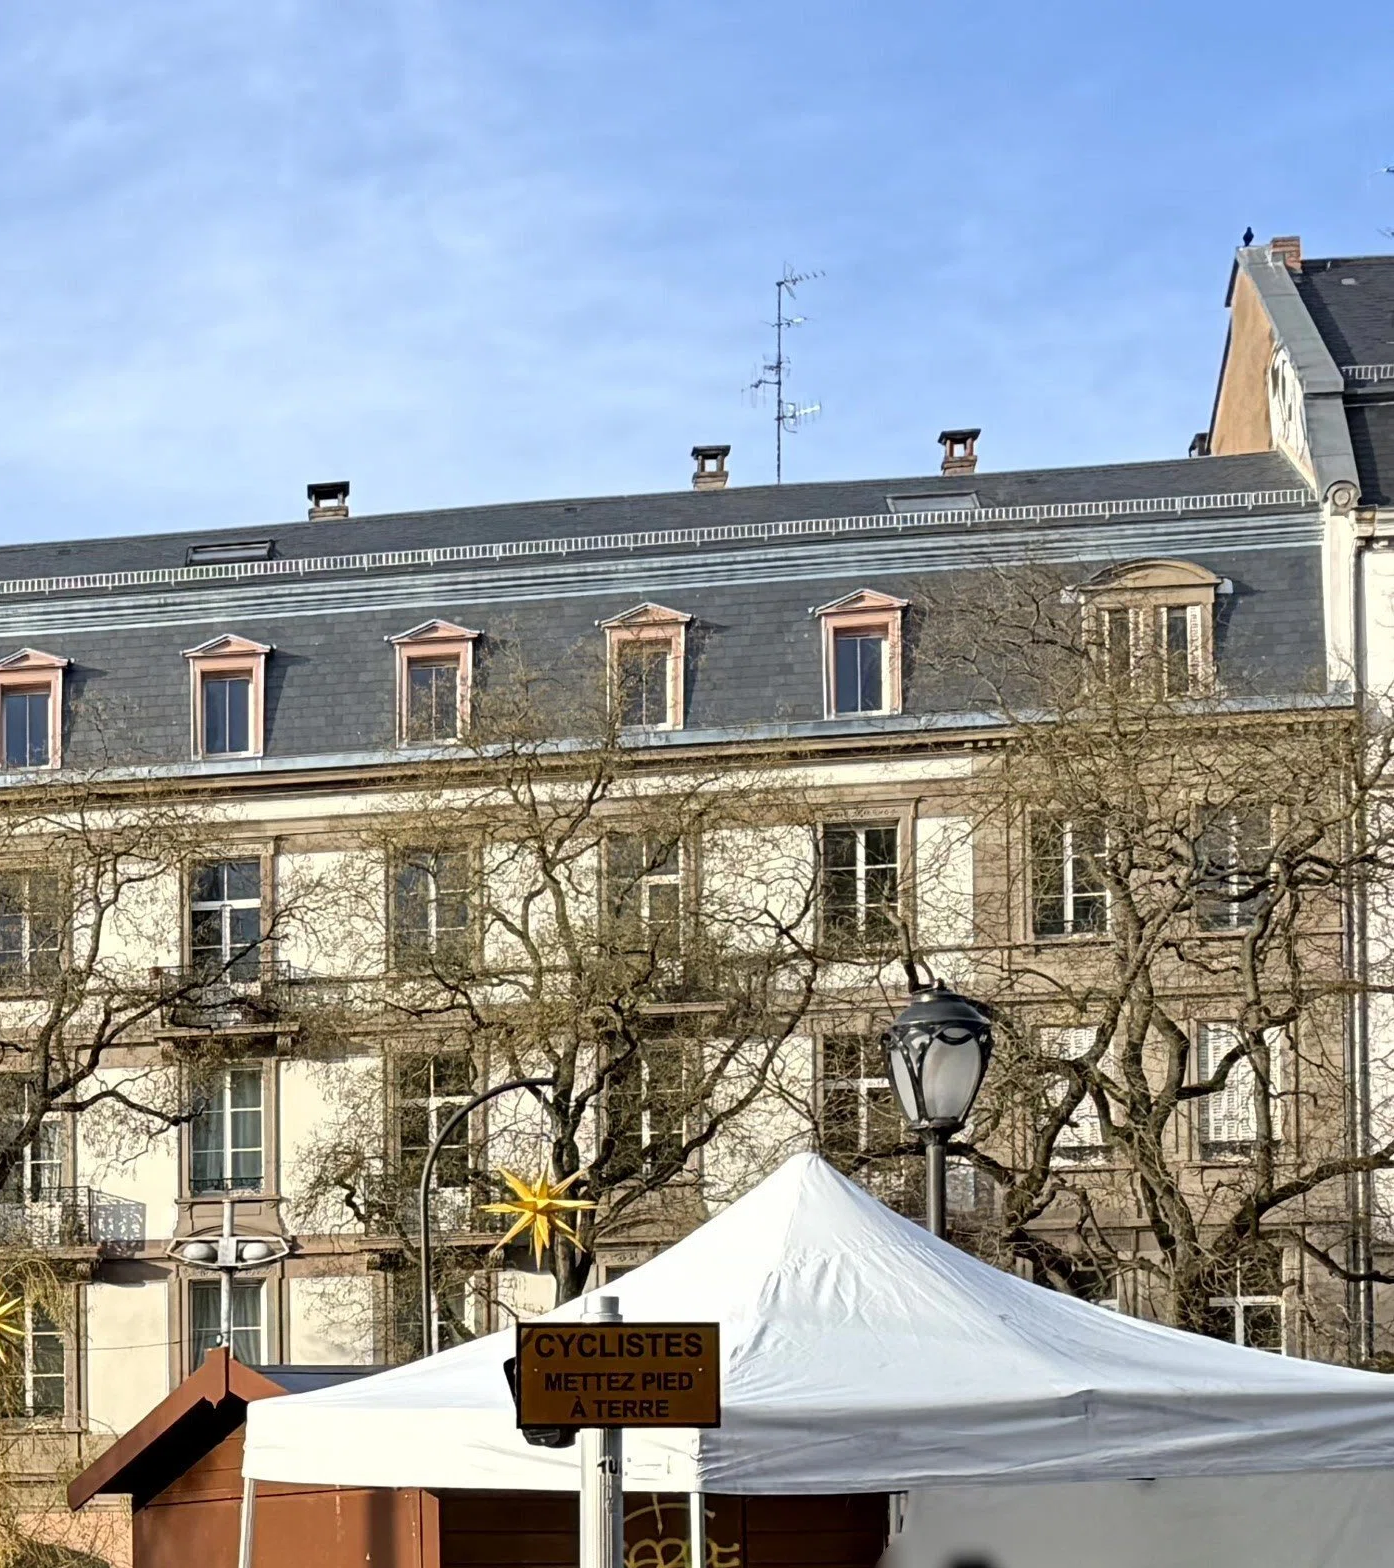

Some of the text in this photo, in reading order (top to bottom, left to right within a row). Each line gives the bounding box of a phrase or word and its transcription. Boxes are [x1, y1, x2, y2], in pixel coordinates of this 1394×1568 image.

[534, 1333, 702, 1358] CYCLISTES
[544, 1372, 693, 1392] METTEZ PIED
[570, 1396, 669, 1418] À TERRE
